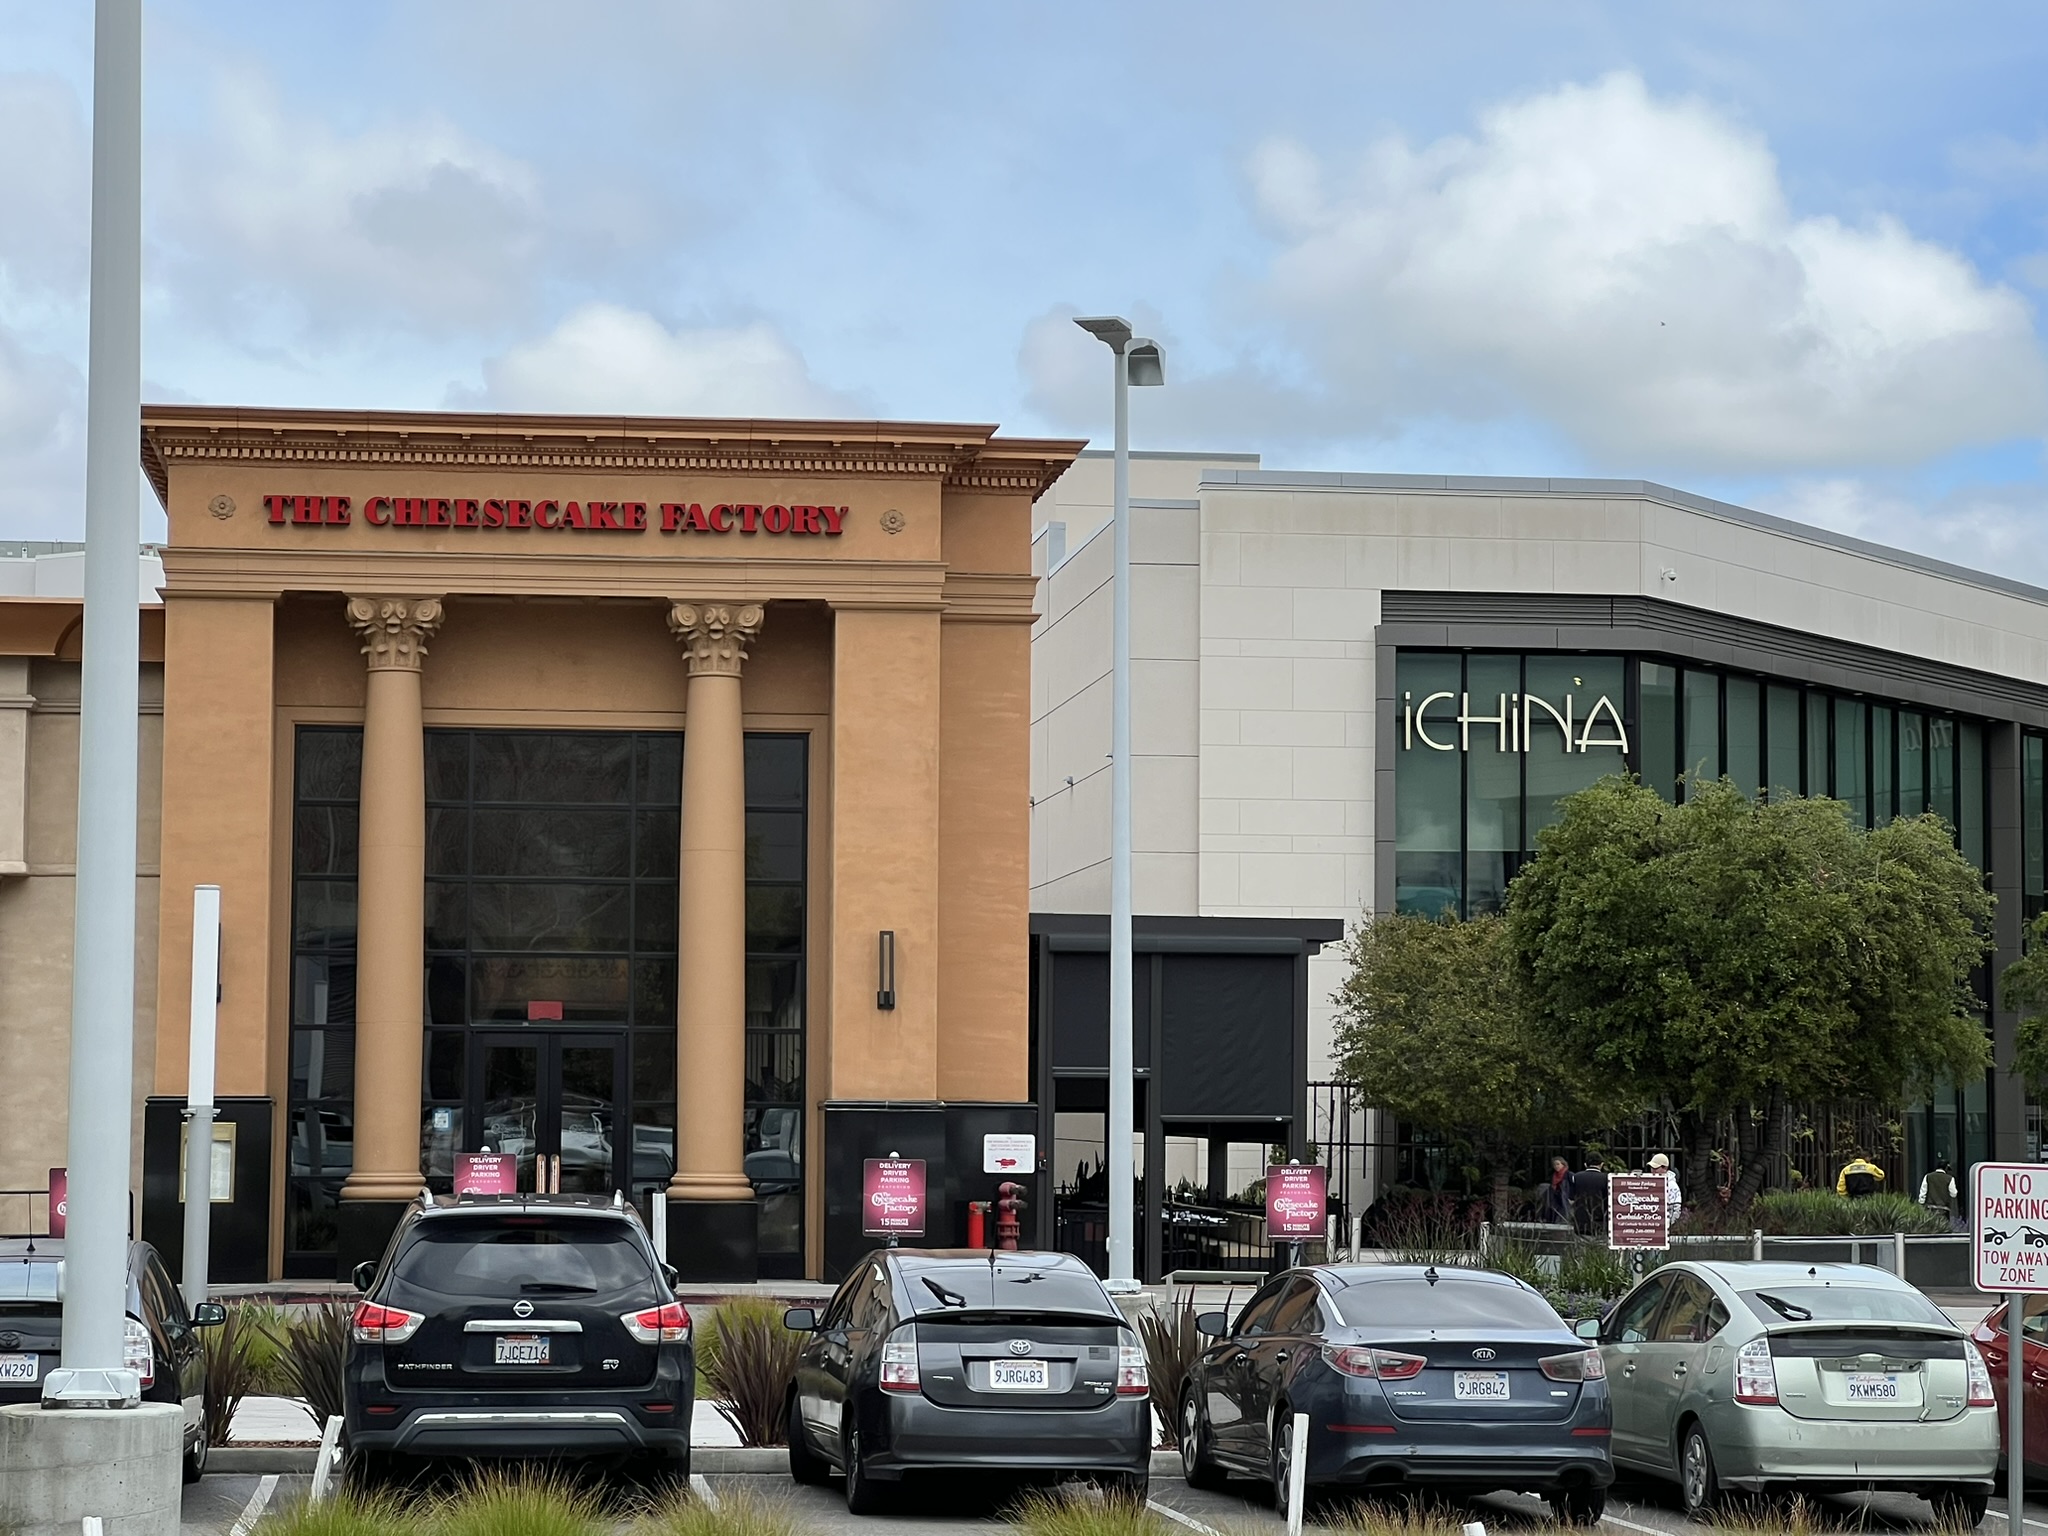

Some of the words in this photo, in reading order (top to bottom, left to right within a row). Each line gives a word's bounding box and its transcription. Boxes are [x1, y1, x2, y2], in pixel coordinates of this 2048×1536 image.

[263, 495, 351, 524] THE
[364, 496, 647, 531] CHEESECAKE
[660, 502, 848, 536] FACTORY
[2004, 1174, 2032, 1195] NO
[872, 1192, 918, 1206] Cheesecake
[1274, 1198, 1318, 1212] Cheesecake
[880, 1218, 890, 1226] 15
[1984, 1250, 2010, 1265] TOW
[2000, 1268, 2036, 1282] ZONE
[498, 1346, 547, 1360] 7JCE716
[995, 1370, 1043, 1383] 9JRG483
[1458, 1382, 1506, 1395] 9JRG842
[1850, 1384, 1896, 1397] 9KWM580
